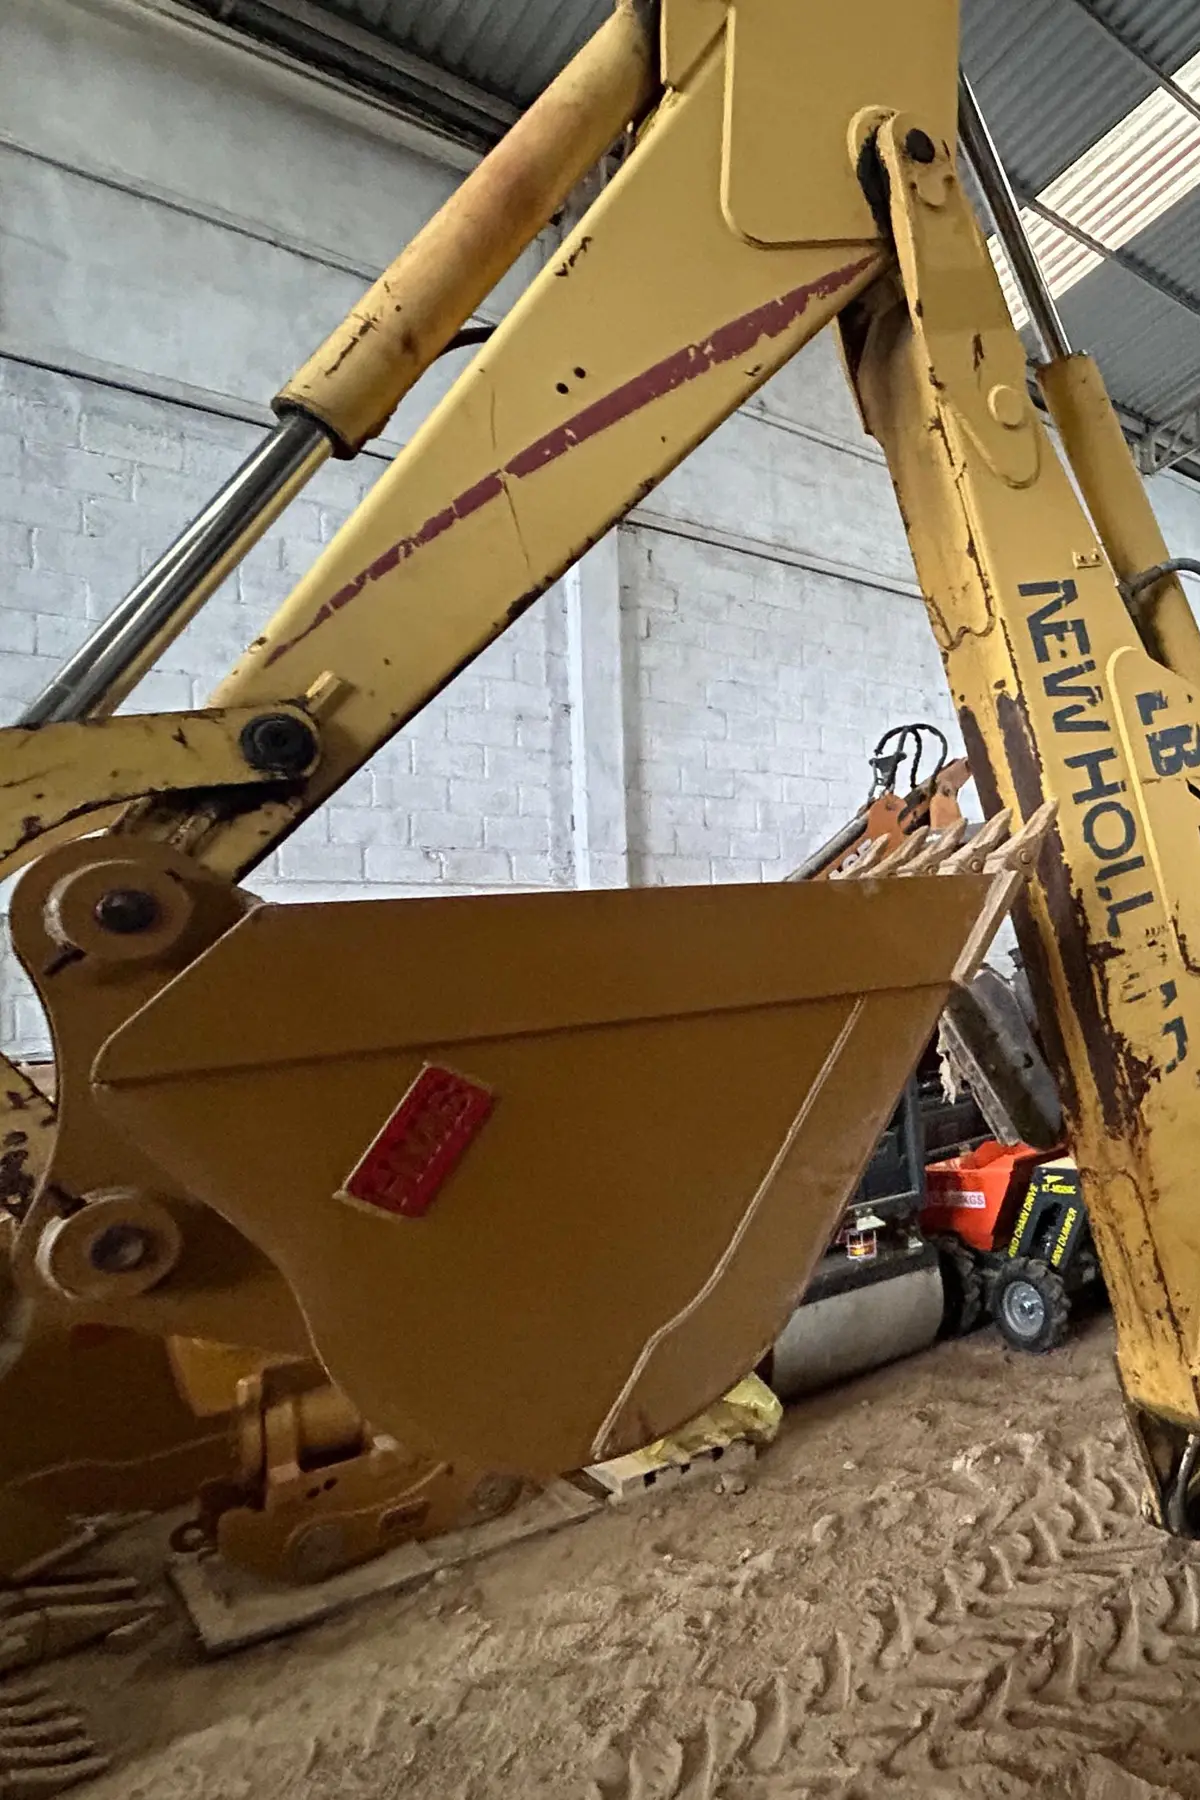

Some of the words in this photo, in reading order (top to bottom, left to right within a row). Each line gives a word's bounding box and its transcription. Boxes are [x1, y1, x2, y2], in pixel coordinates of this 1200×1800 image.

[1018, 579, 1110, 732] NEW
[1023, 1183, 1038, 1212] DRIVE
[1057, 1207, 1077, 1247] DUMPER
